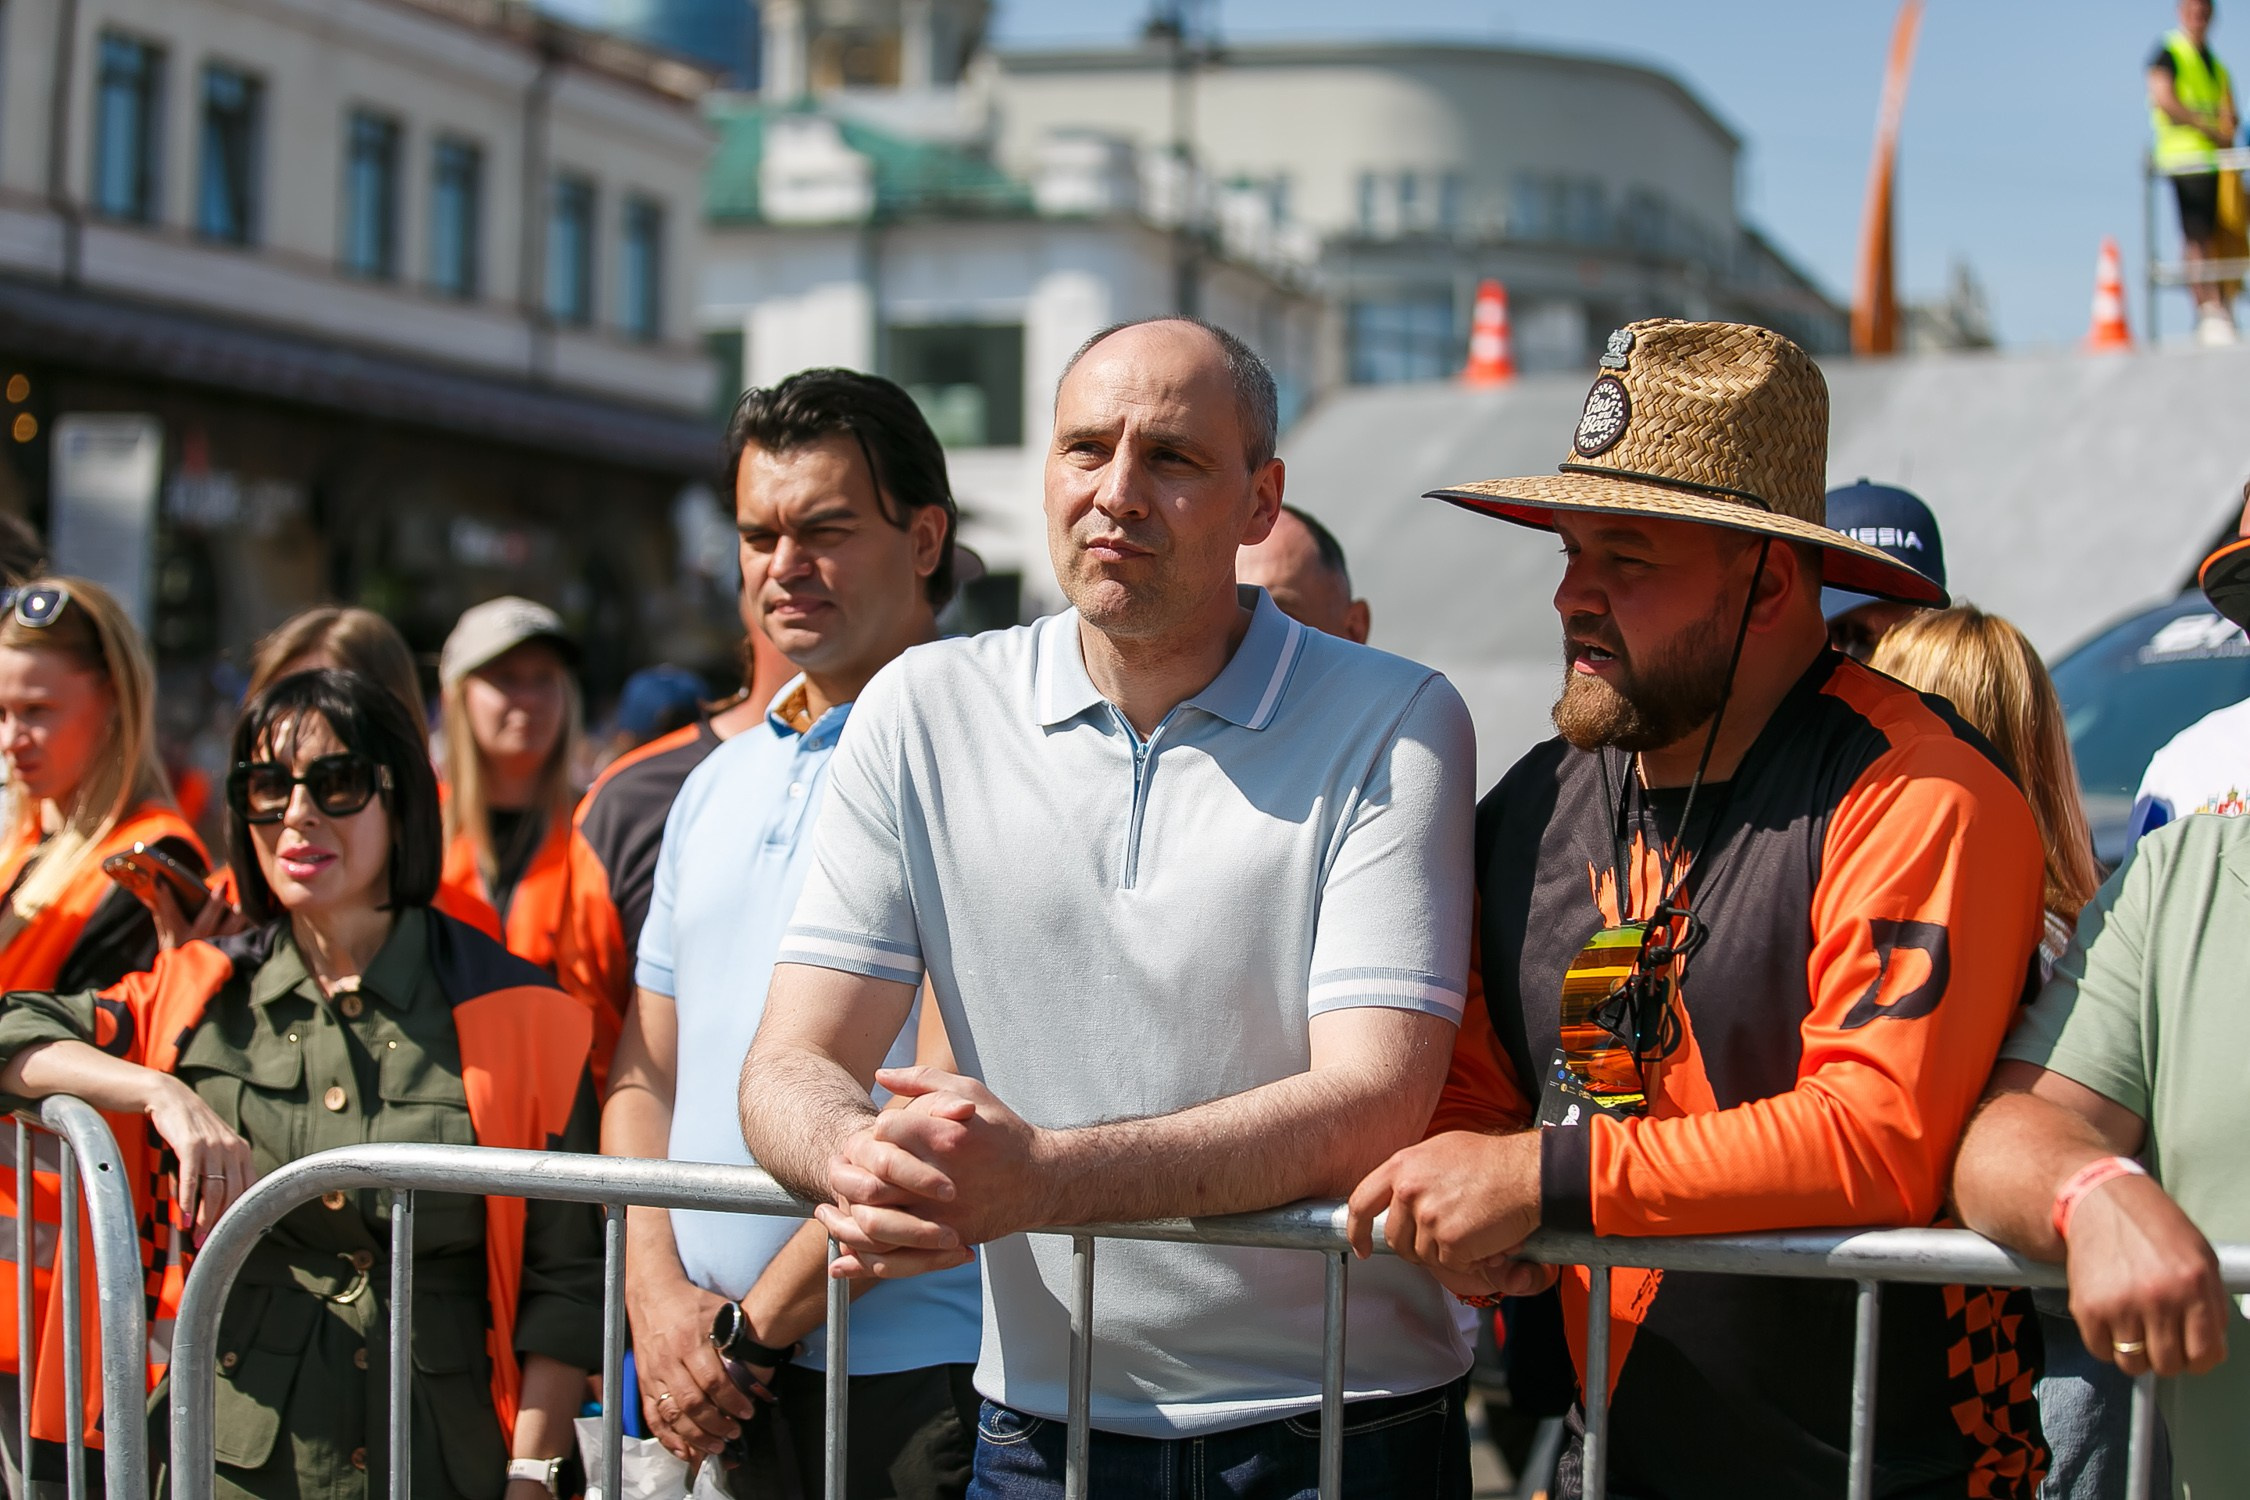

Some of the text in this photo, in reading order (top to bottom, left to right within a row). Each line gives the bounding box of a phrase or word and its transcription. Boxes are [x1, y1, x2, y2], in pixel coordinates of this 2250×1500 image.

[1586, 394, 1617, 415] Gas
[1596, 406, 1615, 419] and
[1579, 413, 1617, 435] Beer
